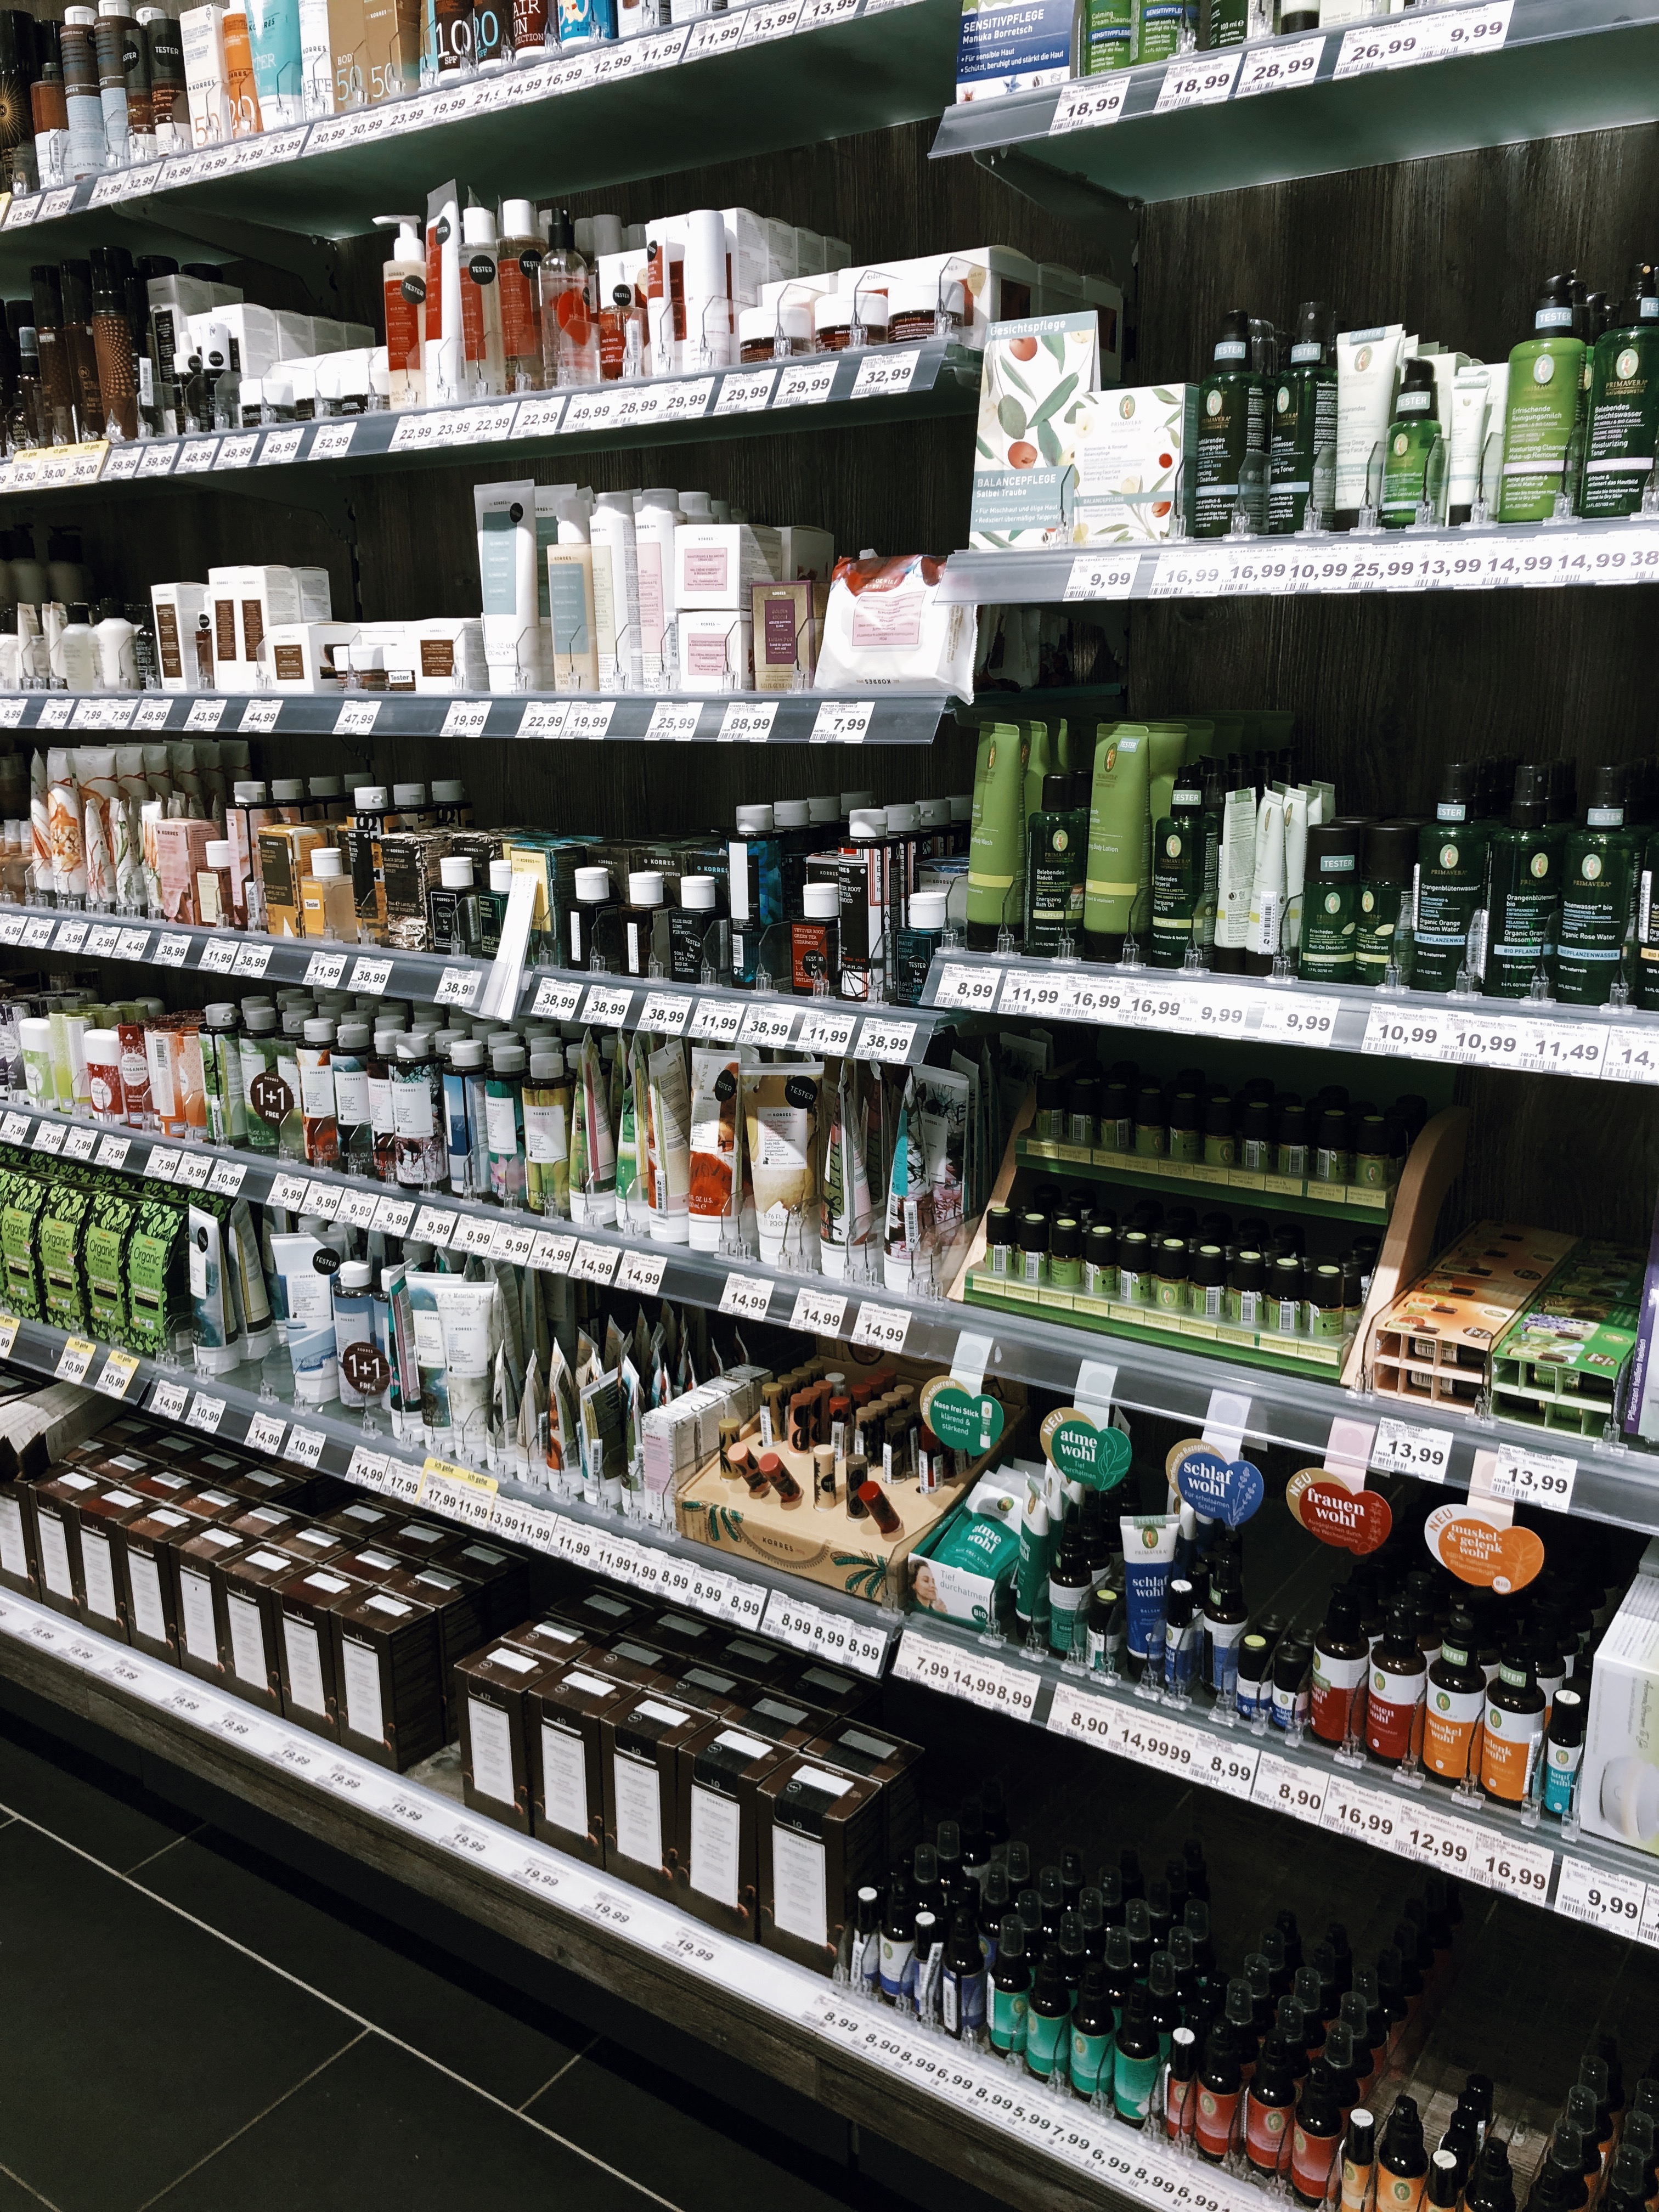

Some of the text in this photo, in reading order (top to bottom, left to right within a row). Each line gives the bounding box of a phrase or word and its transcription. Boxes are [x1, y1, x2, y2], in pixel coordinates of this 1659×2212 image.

[754, 12, 797, 32] 13,99
[964, 9, 1044, 32] SENSITIVPFLEGE
[698, 27, 739, 47] 11,99
[963, 25, 1032, 44] Manuka Borretsch
[1450, 22, 1503, 42] 9,99
[155, 46, 179, 55] TESTER
[966, 48, 1014, 62] Für sensible Haut
[1352, 38, 1416, 61] 26,99
[964, 63, 985, 73] Schützt,
[988, 60, 1010, 71] beruhigt
[1023, 54, 1039, 64] stärkt
[1050, 50, 1063, 59] Haut
[1255, 58, 1313, 80] 28,99
[506, 78, 541, 97] 14,99
[1066, 97, 1119, 117] 18,99
[390, 108, 423, 126] 23,99
[128, 174, 154, 190] 32,99
[1539, 311, 1571, 322] TESTER
[990, 319, 1066, 336] Gesichtspflege
[1216, 345, 1243, 355] TESTER
[865, 367, 911, 384] 32,99
[727, 386, 768, 402] 29,99
[619, 400, 657, 414] 28,99
[1513, 405, 1550, 414] Erfrischende
[1594, 410, 1642, 420] Gesichtswasser
[1595, 404, 1630, 413] Belebendes
[1512, 412, 1562, 421] Reinigungsmilch
[476, 418, 510, 432] 22,99
[1509, 443, 1542, 454] Moisturizing
[1592, 439, 1628, 449] Moisturizing
[111, 459, 135, 470] 59,99
[1277, 465, 1295, 473] Toner
[978, 474, 1056, 488] BALANCEPFLEGE
[1001, 488, 1026, 496] Traube
[1230, 563, 1285, 580] 16,99
[1353, 561, 1414, 579] 25,99
[1419, 557, 1481, 575] 13,99
[1090, 572, 1131, 586] 9,99
[390, 673, 410, 682] Tester
[142, 711, 167, 721] 49,99
[345, 713, 373, 724] 47,99
[730, 719, 770, 730] 88,99
[834, 719, 866, 731] 7,99
[1120, 741, 1136, 749] TESTER
[1173, 793, 1198, 802] TESTER
[1324, 859, 1353, 868] TESTER
[1036, 896, 1062, 905] Energizing
[32, 929, 49, 940] 8,99
[126, 941, 144, 951] 4,49
[313, 966, 340, 978] 11,99
[957, 983, 992, 998] 8,99
[591, 1001, 625, 1015] 38,99
[1073, 994, 1120, 1009] 16,99
[1286, 1014, 1330, 1031] 9,99
[867, 1034, 908, 1051] 38,99
[1455, 1034, 1516, 1052] 10,99
[1536, 1041, 1599, 1060] 11,49
[717, 1081, 732, 1091] TESTER
[790, 1086, 814, 1101] TESTER
[257, 1084, 286, 1109] 1+1
[266, 1110, 279, 1119] FREE
[12, 1125, 25, 1136] 7,99
[217, 1173, 240, 1187] 10,99
[44, 1232, 70, 1248] Organic
[506, 1239, 529, 1252] 9,99
[134, 1248, 160, 1265] Organic
[317, 1256, 336, 1267] TESTER
[541, 1247, 571, 1261] 14,99
[865, 1323, 903, 1341] 14,99
[64, 1364, 84, 1374] 10,99
[348, 1355, 380, 1380] 1+1
[1632, 1366, 1643, 1390] helfen
[934, 1400, 979, 1418] Nase frei Stick
[1627, 1392, 1639, 1421] Pflanzen
[941, 1413, 963, 1423] klärend
[1043, 1411, 1064, 1435] NEU
[255, 1430, 279, 1444] 14,99
[942, 1423, 969, 1436] stärkend
[1060, 1429, 1098, 1448] atme
[1062, 1445, 1096, 1463] wohl
[1388, 1441, 1443, 1465] 13,99
[1184, 1462, 1233, 1485] schlaf
[391, 1476, 417, 1494] 17,99
[1188, 1479, 1224, 1498] wohl
[1289, 1472, 1312, 1496] NEU
[1307, 1487, 1364, 1516] frauen
[1316, 1507, 1356, 1529] wohl
[1429, 1508, 1453, 1532] NEU
[972, 1524, 1002, 1544] atme
[1451, 1523, 1503, 1543] muskel-
[558, 1536, 590, 1556] 11,99
[763, 1537, 793, 1552] KORRES
[967, 1535, 996, 1554] wohl
[1459, 1545, 1489, 1560] wohl
[1460, 1536, 1503, 1553] gelenk
[940, 1570, 955, 1582] Tief
[1132, 1576, 1167, 1588] schlaf
[940, 1580, 988, 1602] durchatmen
[1136, 1586, 1164, 1598] wohl
[731, 1596, 759, 1616] 8,99
[973, 1609, 986, 1618] BIO
[916, 1656, 949, 1679] 7,99
[1071, 1712, 1108, 1735] 8,90
[1339, 1804, 1393, 1835] 16,99
[524, 1868, 559, 1887] 19,99
[1485, 1856, 1545, 1891] 16,99
[1588, 1889, 1638, 1919] 9,99
[677, 1939, 714, 1962] 19,99
[865, 2034, 900, 2055] 8,90
